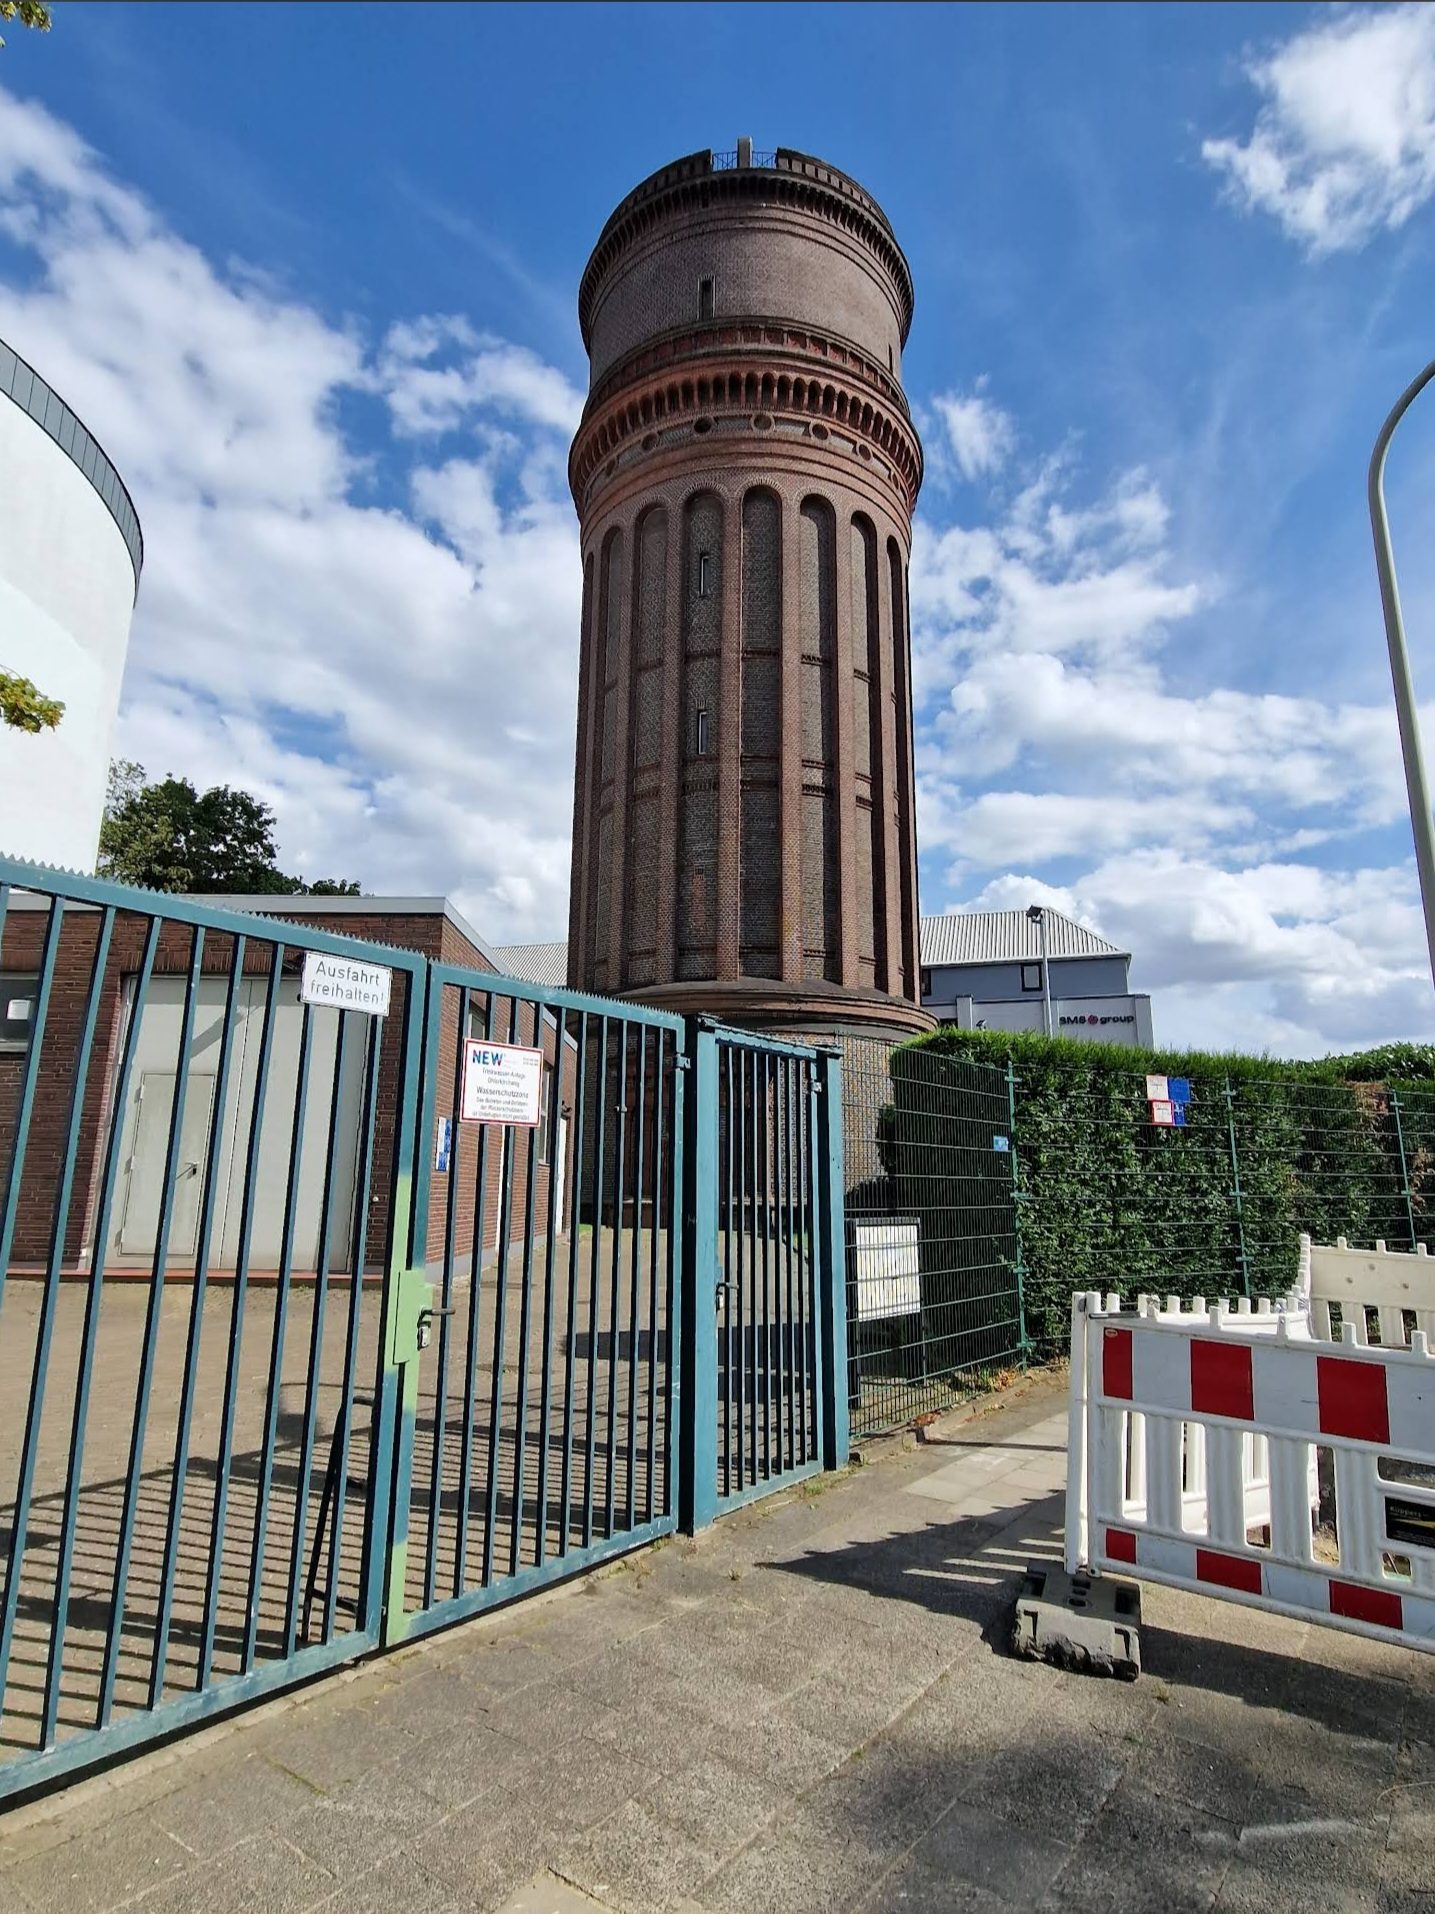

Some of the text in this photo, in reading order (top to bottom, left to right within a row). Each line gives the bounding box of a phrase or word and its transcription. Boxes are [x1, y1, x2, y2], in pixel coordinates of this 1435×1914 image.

[315, 960, 380, 986] Ausfahrt
[310, 979, 384, 1005] freihalten!
[1099, 1015, 1135, 1025] group
[472, 1049, 503, 1067] NEW
